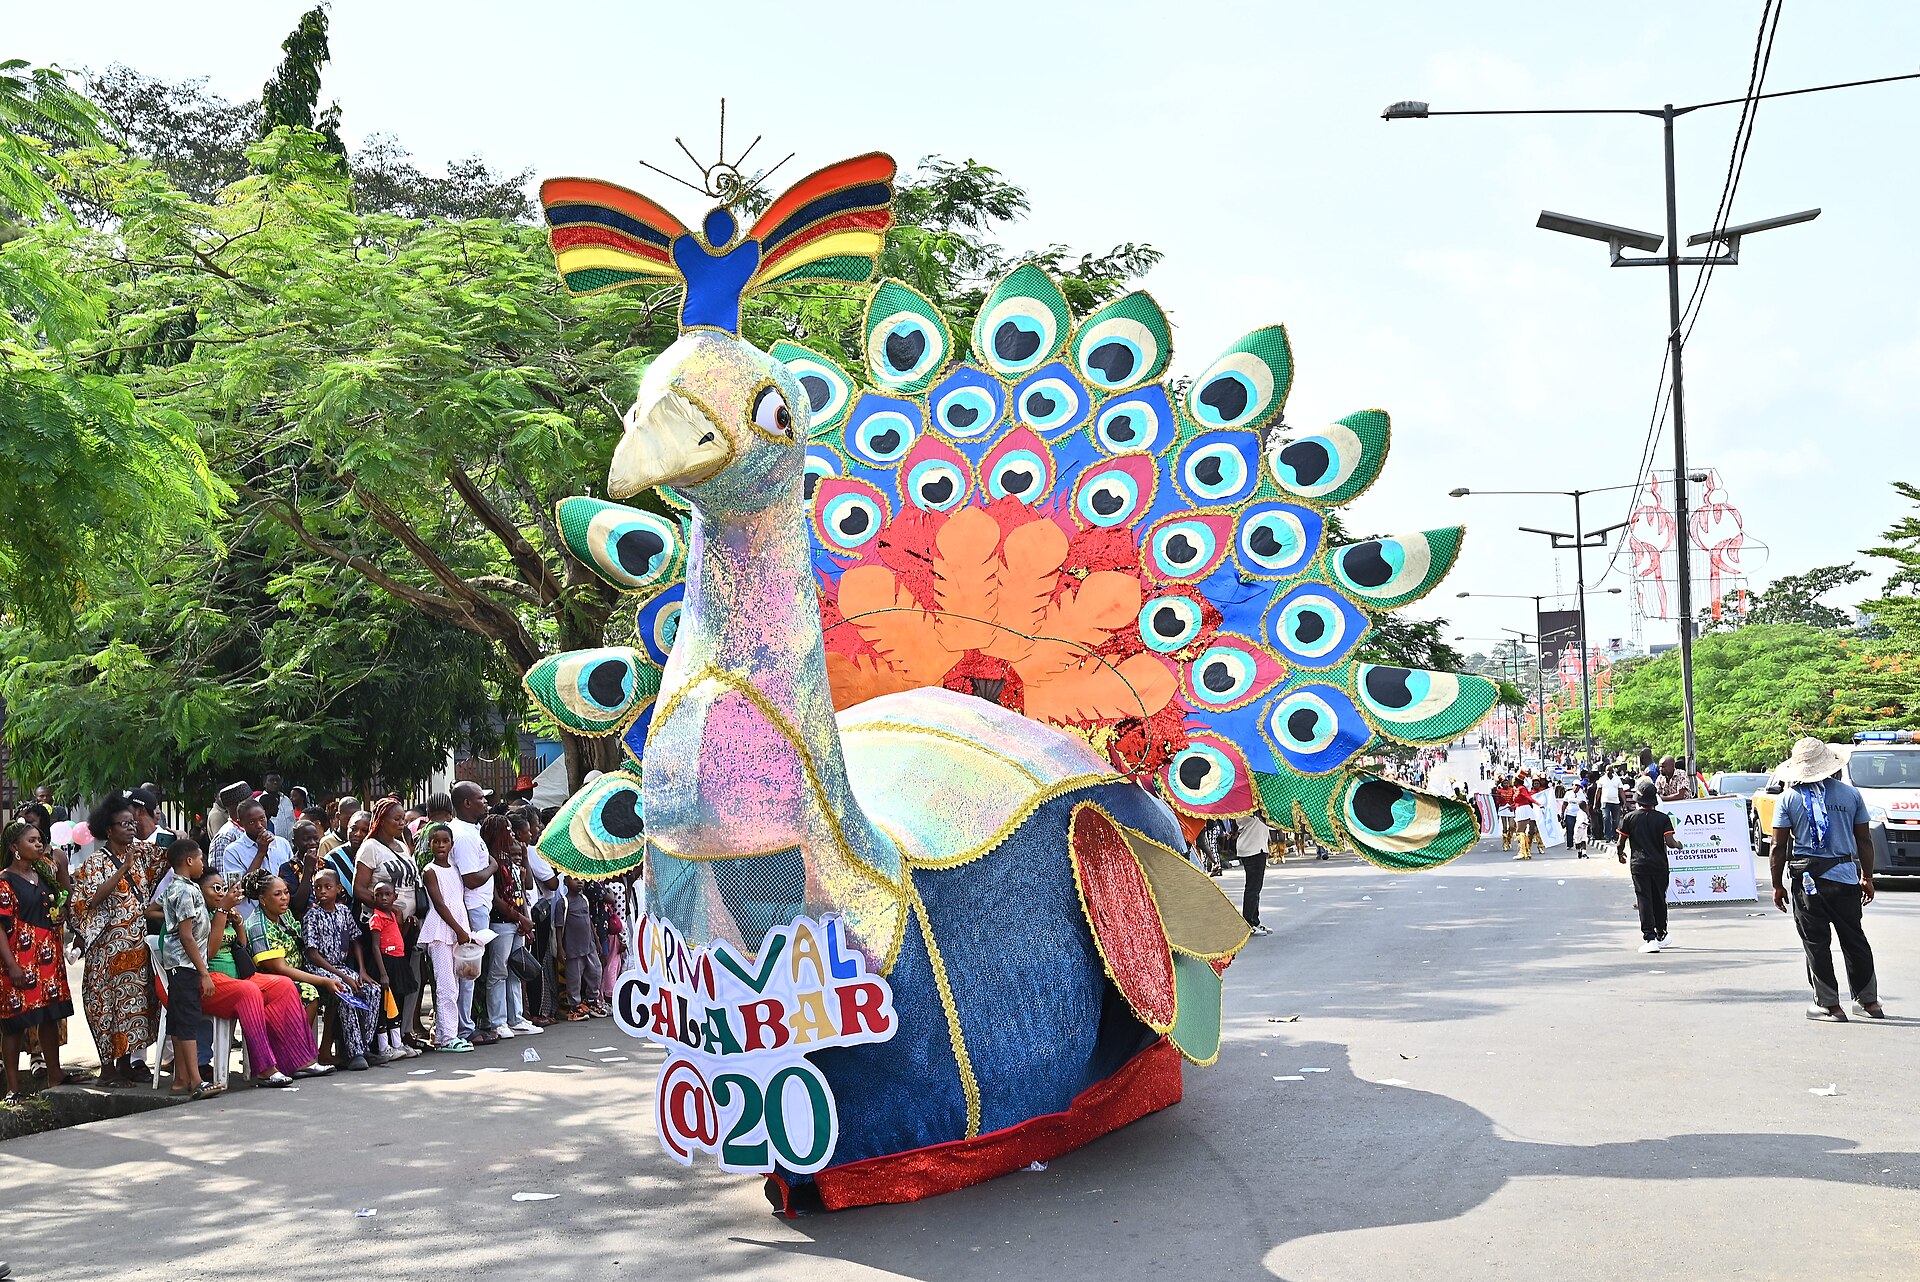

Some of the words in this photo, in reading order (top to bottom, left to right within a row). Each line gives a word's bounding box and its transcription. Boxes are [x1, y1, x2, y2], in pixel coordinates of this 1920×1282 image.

[1684, 813, 1726, 826] ARISE
[1826, 804, 1848, 812] HALL
[637, 914, 858, 1002] CARNIVAL
[618, 979, 890, 1055] CALABAR
[660, 1060, 831, 1166] @20
